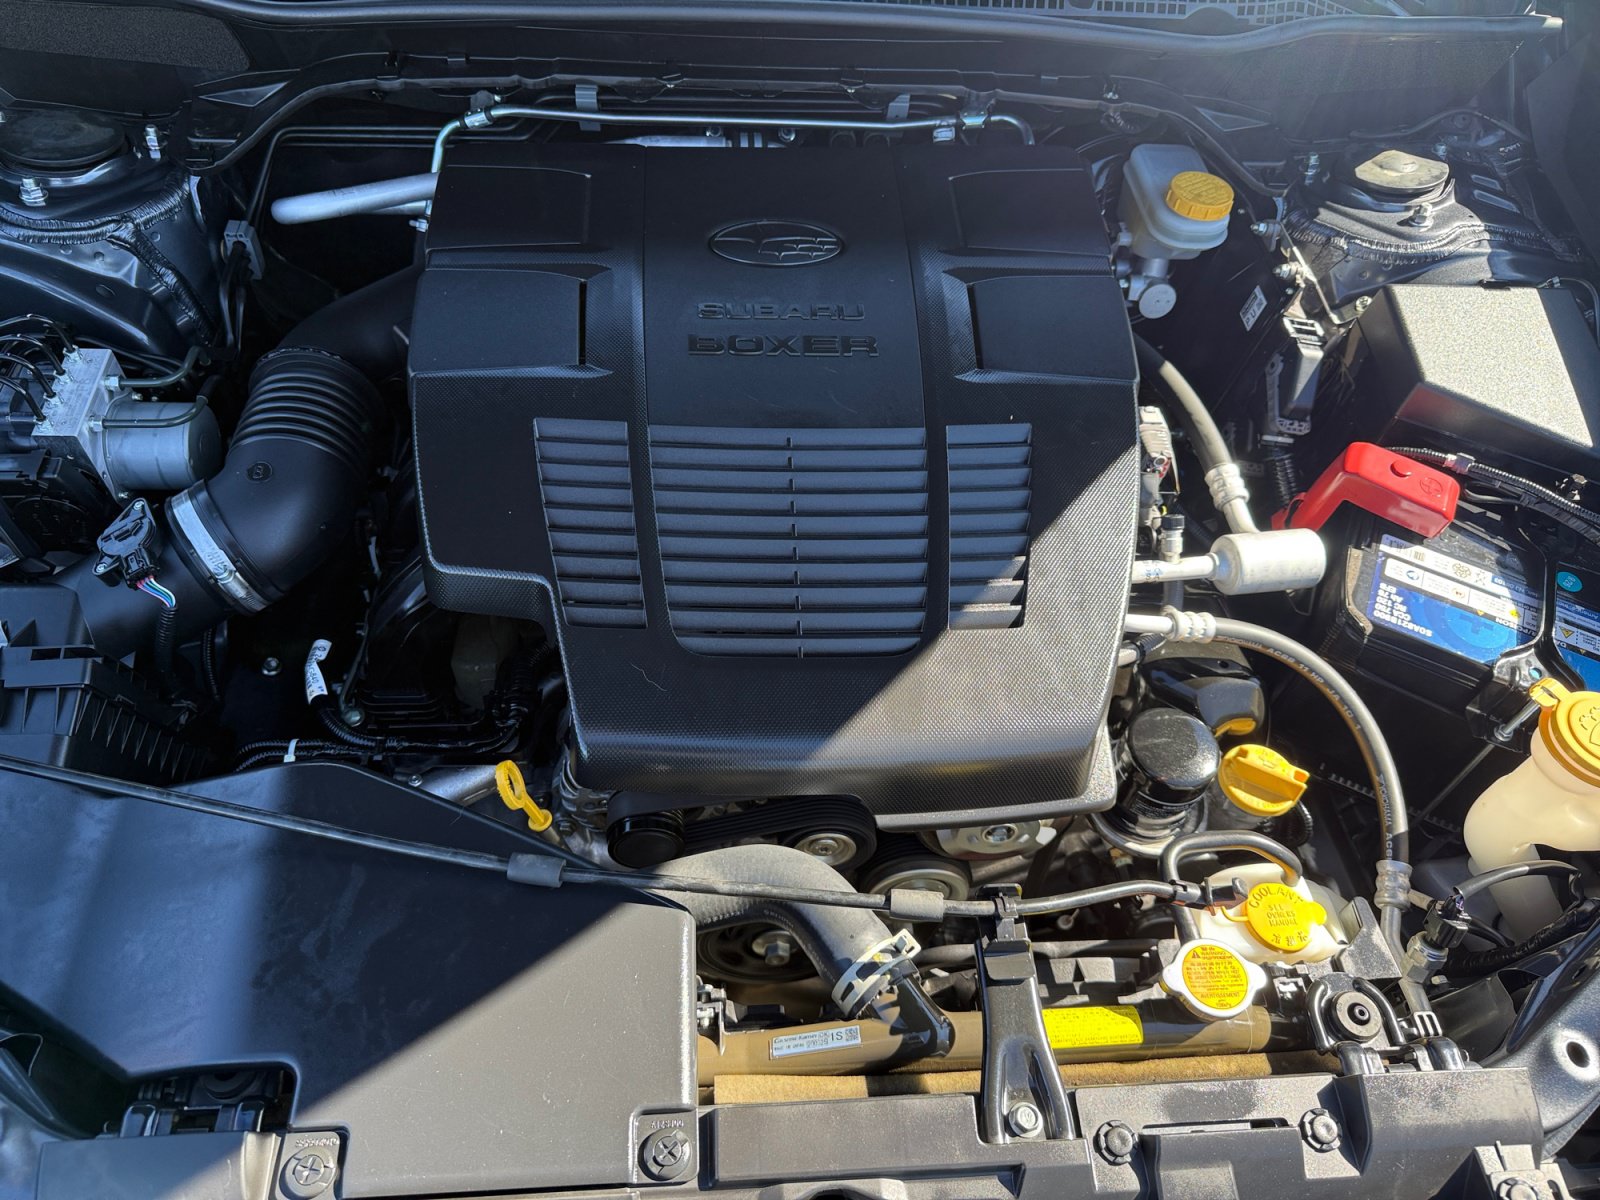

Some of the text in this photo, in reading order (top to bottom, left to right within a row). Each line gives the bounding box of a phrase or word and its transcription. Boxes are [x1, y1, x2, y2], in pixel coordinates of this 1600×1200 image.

[698, 303, 865, 320] SUBARU
[688, 334, 879, 356] BOXER
[1248, 885, 1303, 908] COOLANT
